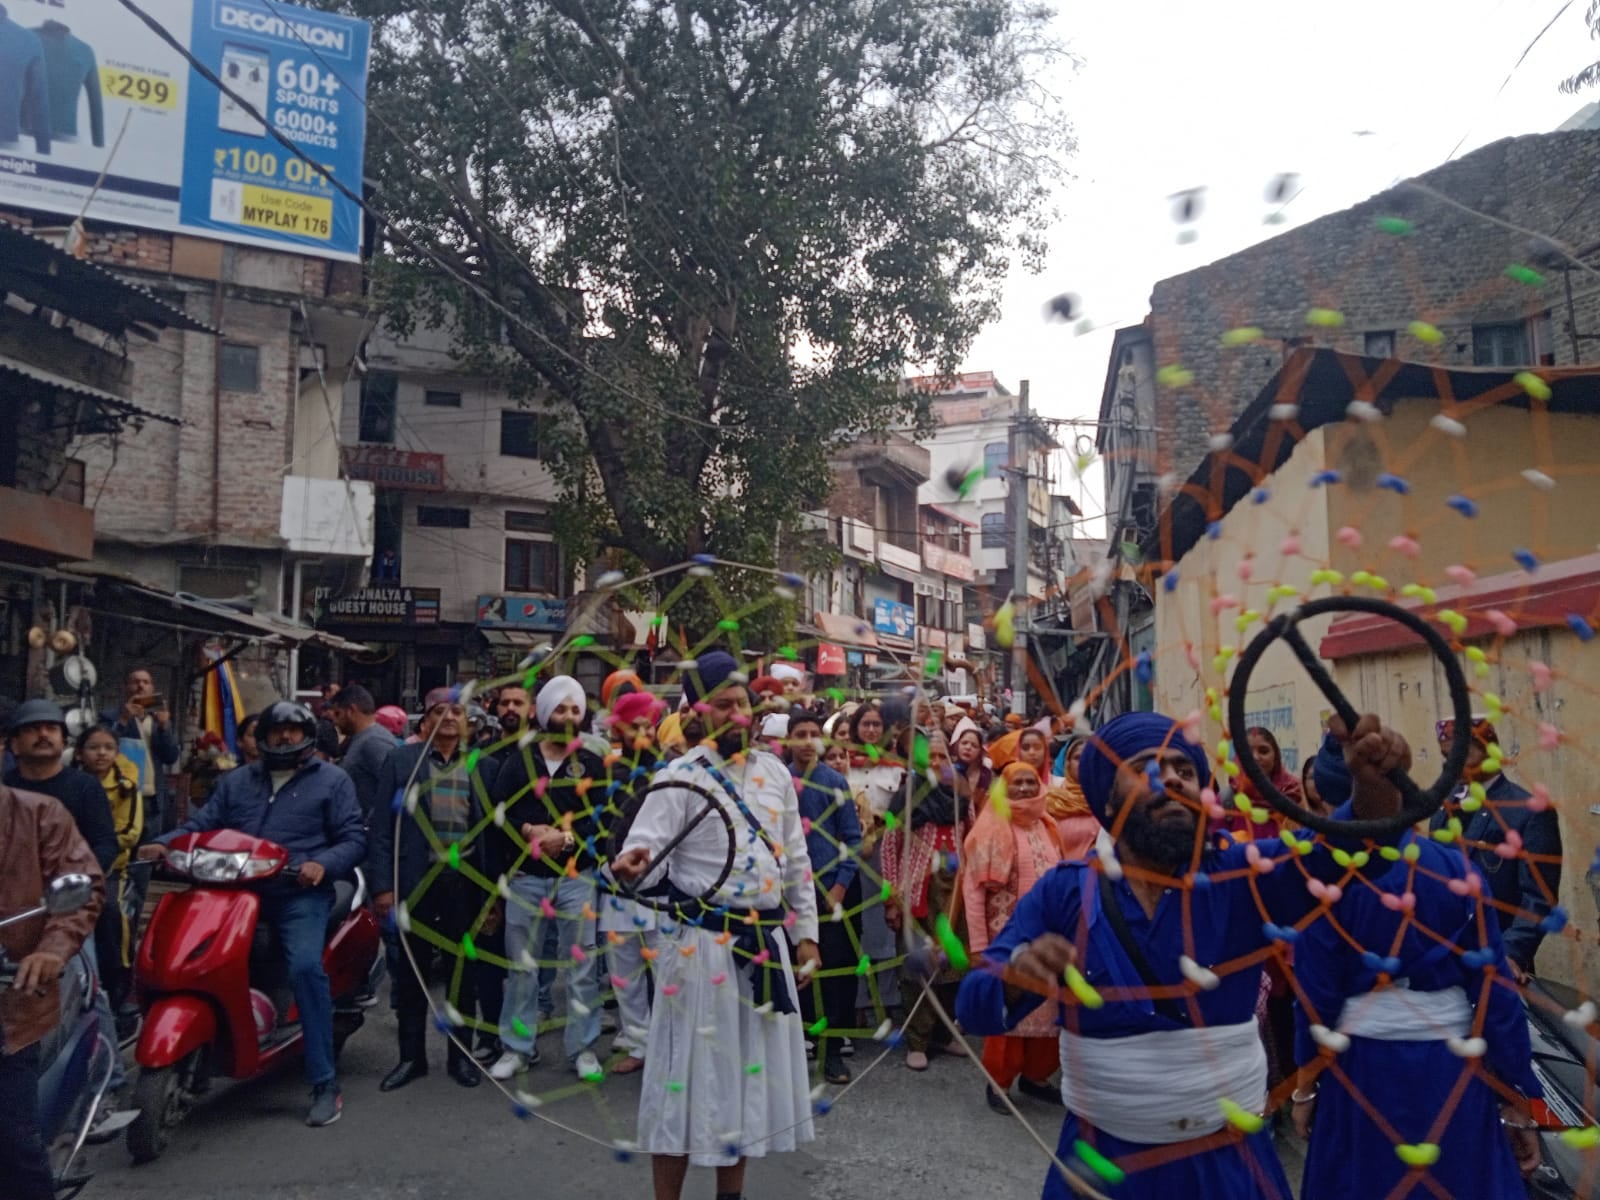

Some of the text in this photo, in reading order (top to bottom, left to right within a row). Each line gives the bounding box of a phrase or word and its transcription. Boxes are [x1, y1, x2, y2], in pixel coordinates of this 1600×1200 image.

[221, 5, 345, 50] DECATHLON
[105, 73, 169, 104] ₹299
[277, 59, 340, 96] 60+
[275, 87, 339, 115] SPORTS
[274, 107, 338, 135] 6000+
[274, 125, 338, 149] PRODUCTS
[214, 147, 336, 188] ₹100 OFF
[260, 193, 313, 212] Use Code
[243, 205, 328, 235] MYPLAY 176
[329, 602, 366, 614] GUEST
[368, 603, 407, 616] HOUSE
